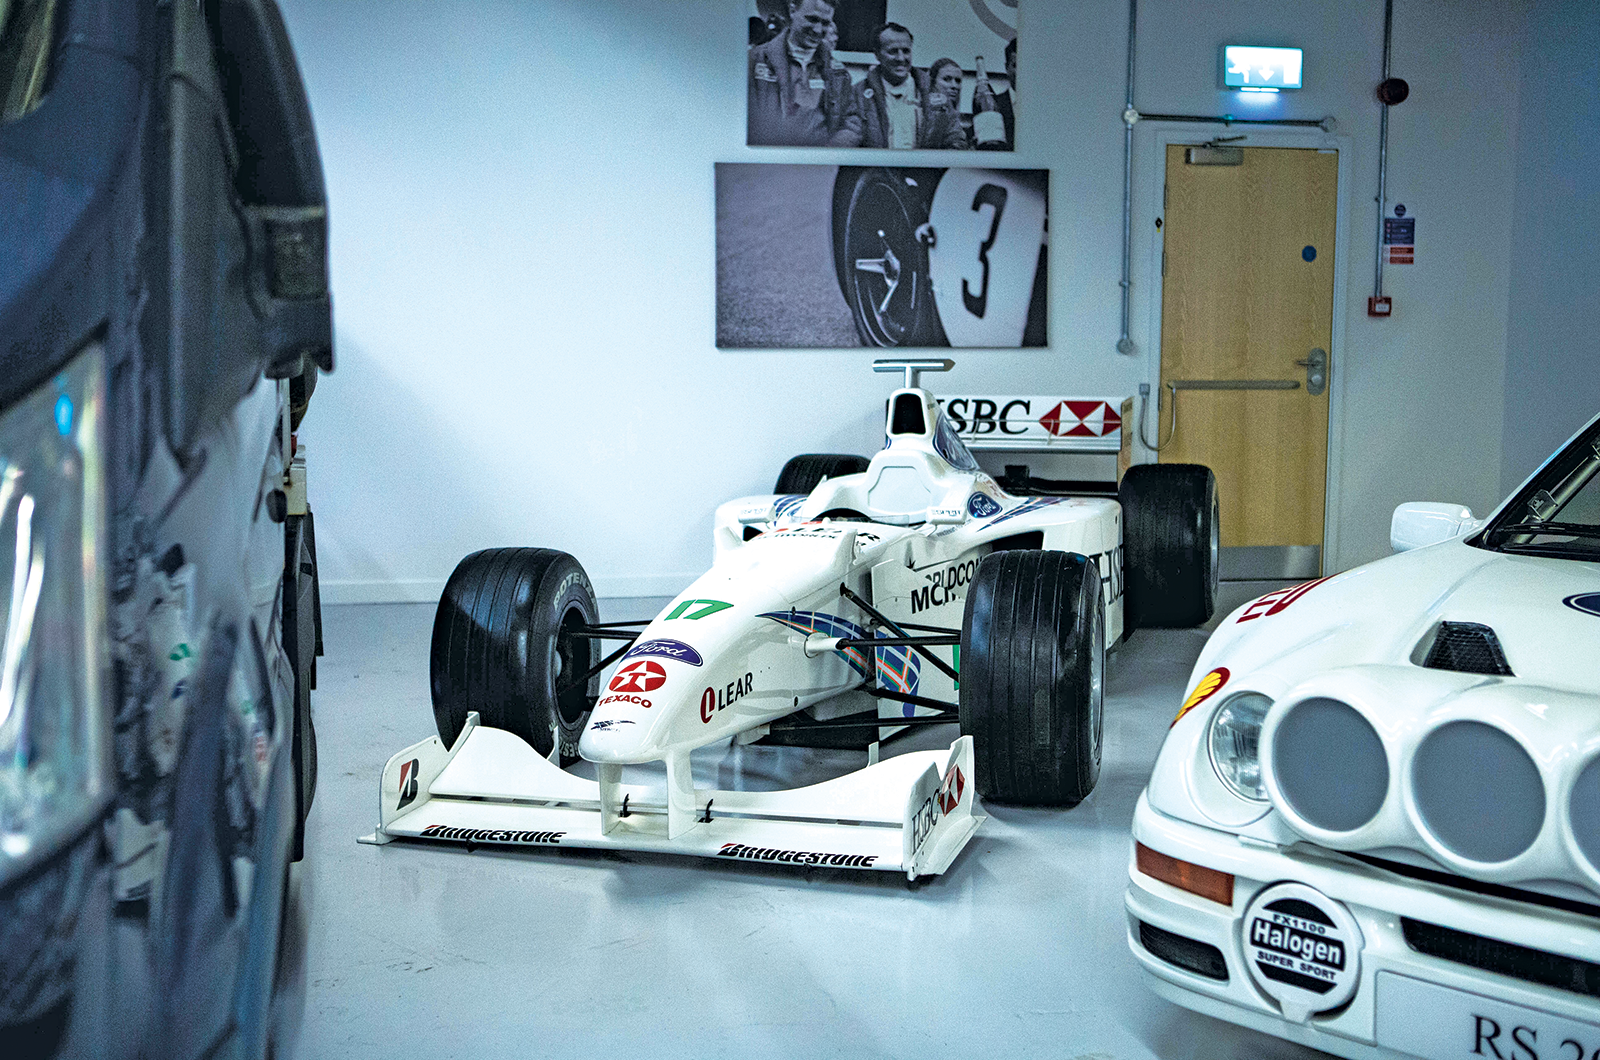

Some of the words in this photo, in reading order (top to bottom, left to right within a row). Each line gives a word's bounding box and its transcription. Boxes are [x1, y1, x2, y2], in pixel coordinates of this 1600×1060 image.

[961, 182, 1008, 319] 3
[936, 399, 1031, 434] SBC
[664, 599, 734, 621] 17
[630, 641, 688, 657] Ford
[598, 694, 652, 709] TEXACO
[718, 672, 753, 711] LEAR
[420, 825, 567, 844] BRIDGESTONE
[912, 787, 941, 854] HSBC
[717, 843, 879, 868] BRIDGESTONE
[1273, 913, 1326, 935] FX1100
[1253, 919, 1341, 965] Halogen
[1257, 950, 1294, 968] SUPER
[1300, 962, 1336, 981] SPORT
[1470, 1012, 1539, 1060] RS
